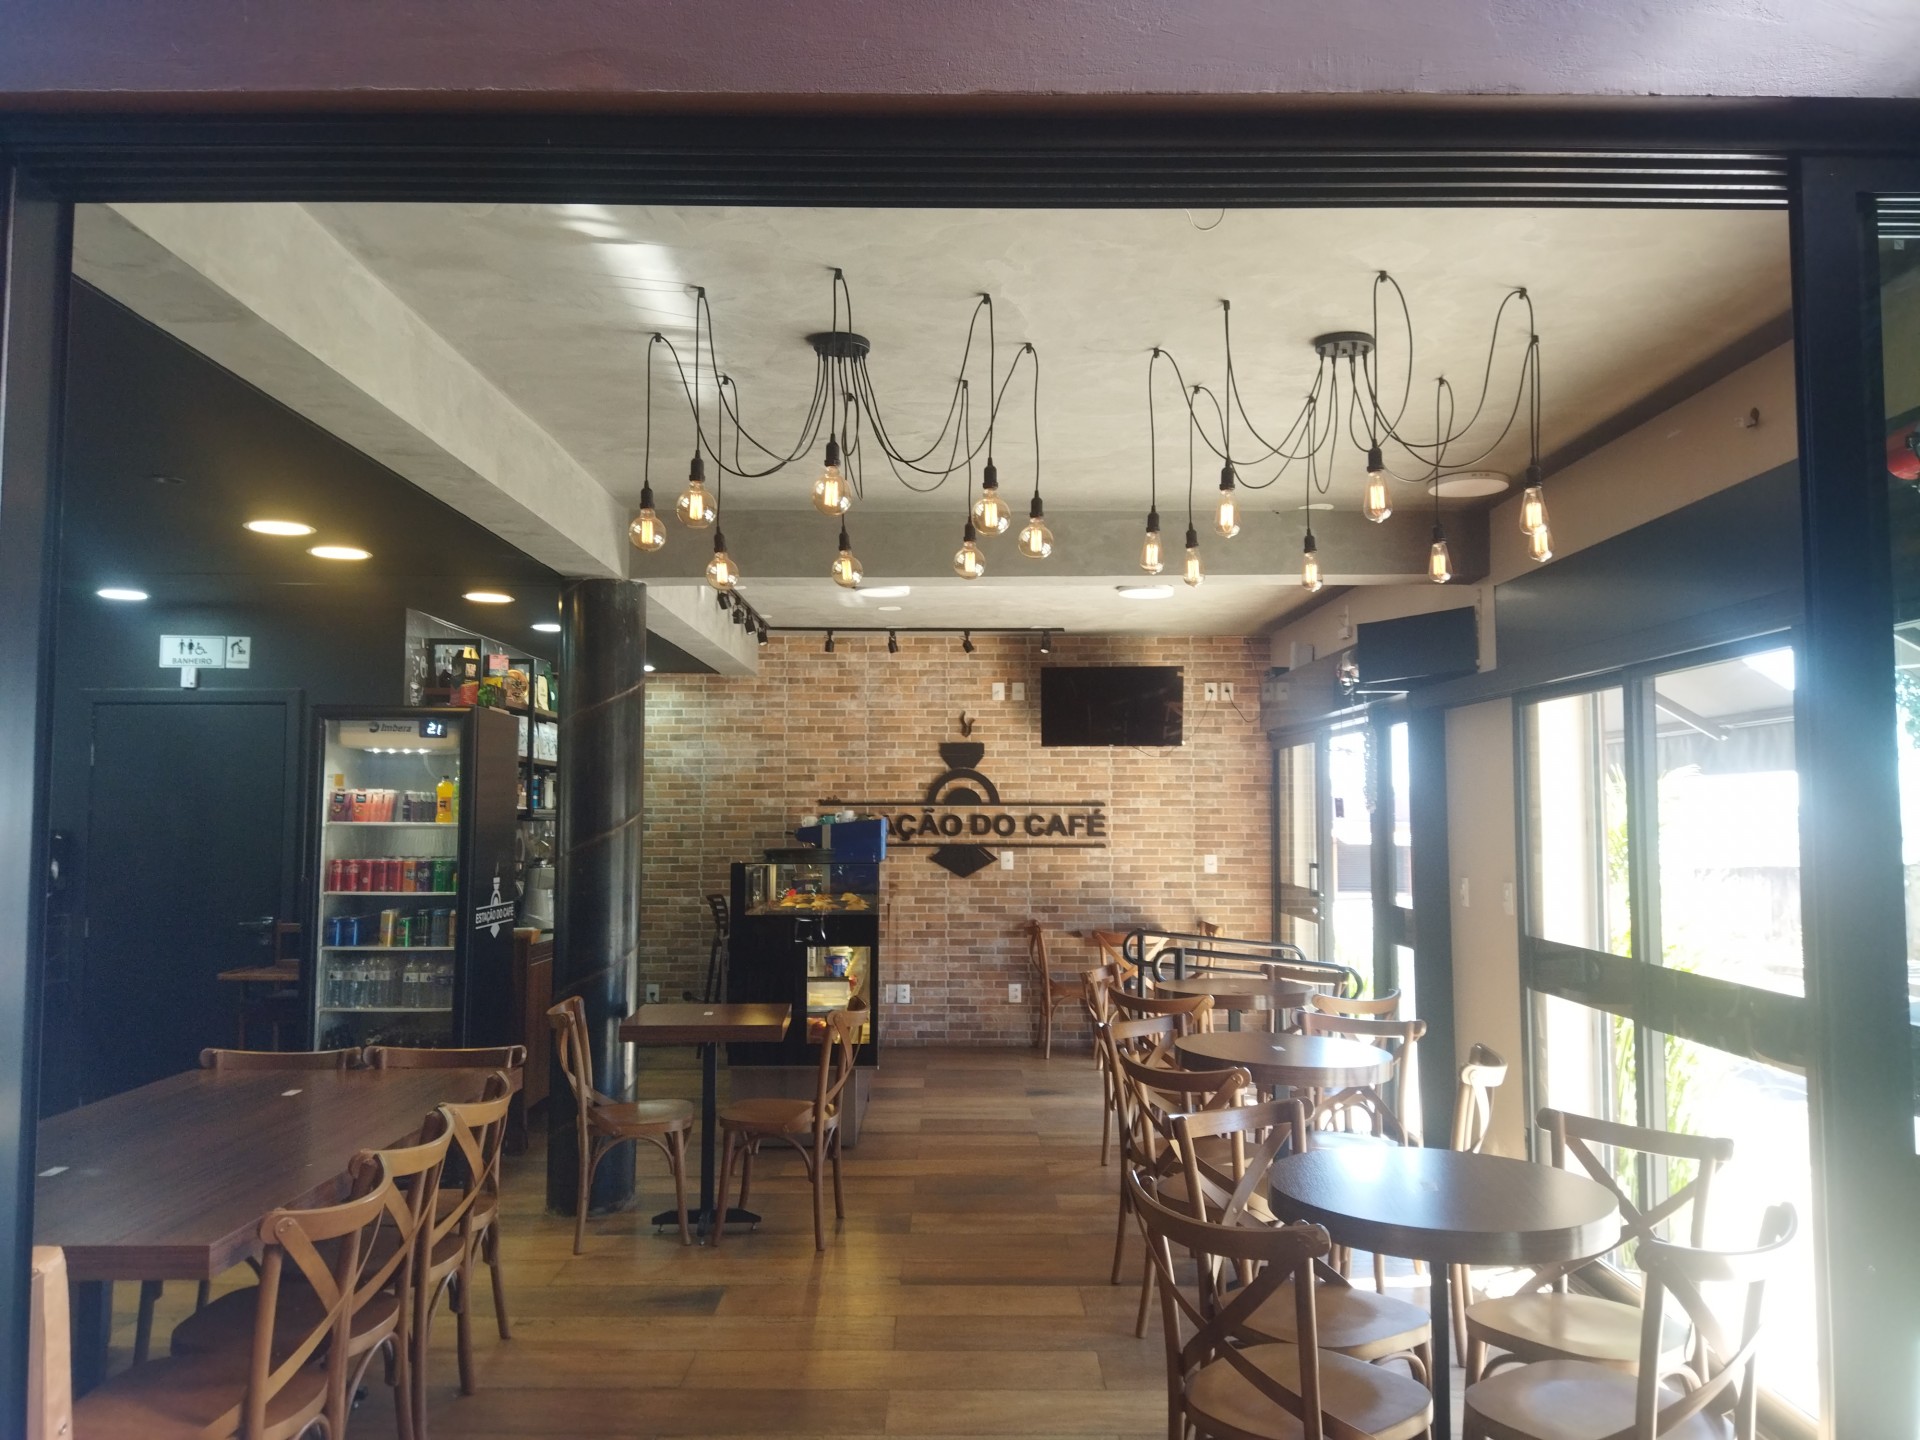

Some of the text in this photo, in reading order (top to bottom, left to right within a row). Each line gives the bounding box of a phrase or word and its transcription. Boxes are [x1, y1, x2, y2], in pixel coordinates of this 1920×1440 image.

[172, 657, 213, 665] BANHEIRO
[380, 723, 412, 733] Imbera
[882, 807, 1107, 842] AÇÃO DO CAFÉ
[475, 908, 496, 924] ESTAÇÃO
[503, 903, 514, 917] CAFÉ
